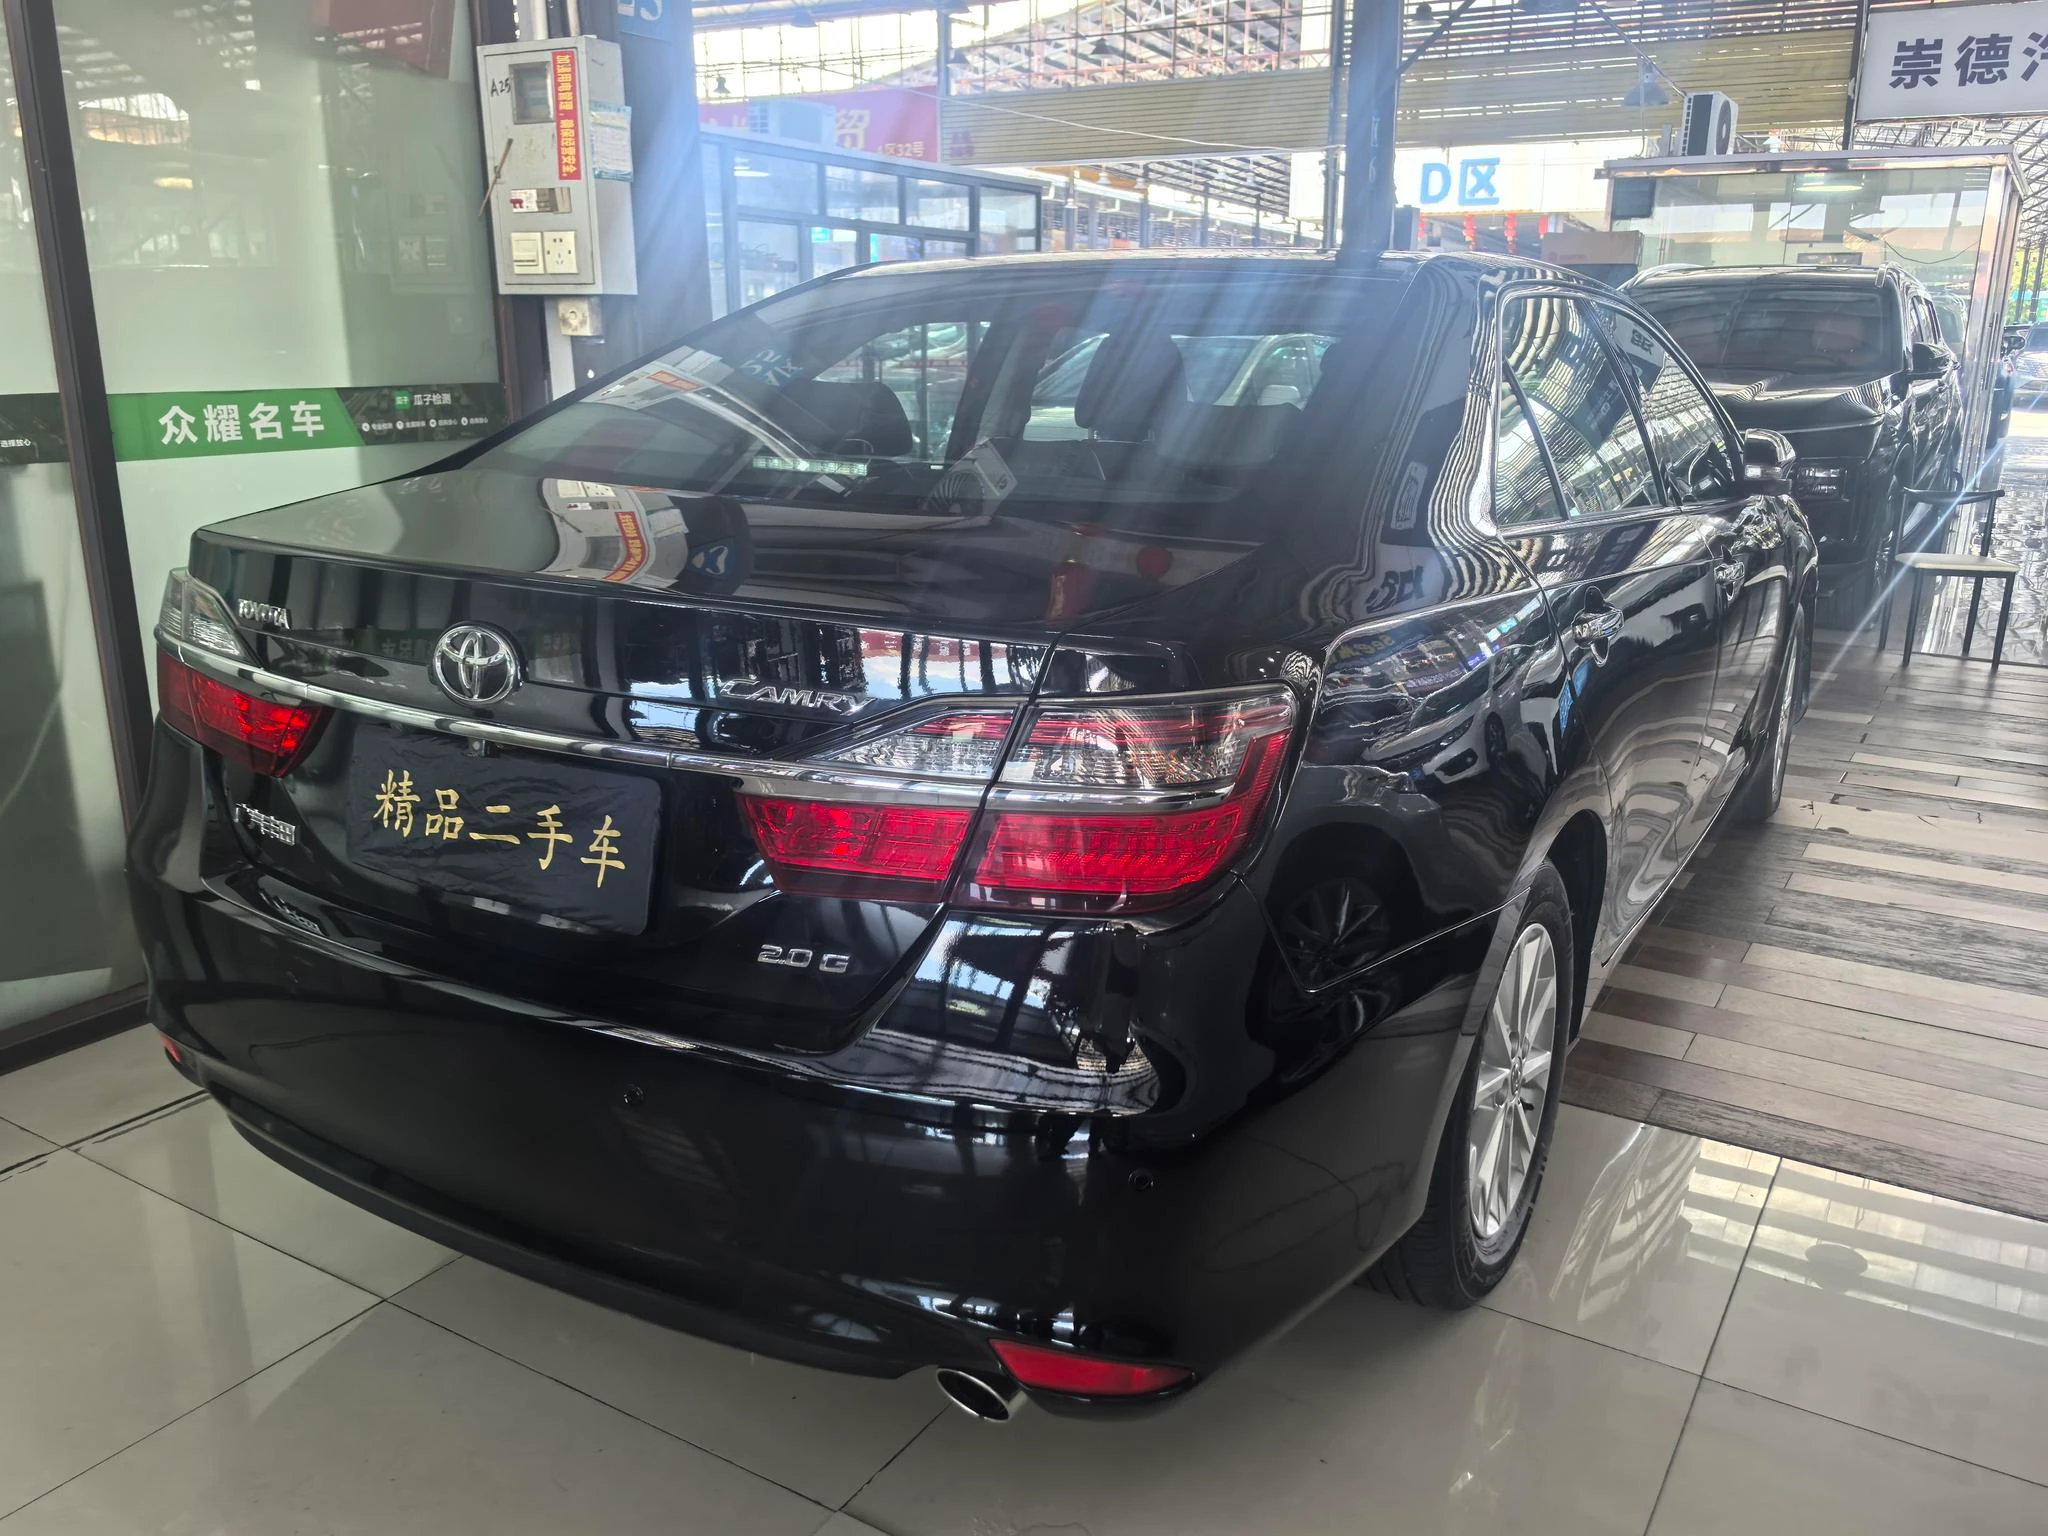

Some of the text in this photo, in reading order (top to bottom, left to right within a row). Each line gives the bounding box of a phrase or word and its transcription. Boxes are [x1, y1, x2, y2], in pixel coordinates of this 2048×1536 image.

[490, 77, 511, 97] A25
[1419, 157, 1501, 207] D区
[413, 392, 452, 406] 瓜子检测
[158, 400, 325, 445] 众耀名车
[238, 598, 290, 630] TOYOTA
[720, 678, 877, 717] CAMRY
[373, 769, 626, 888] 精品二手车
[757, 944, 851, 974] 2.0 G
